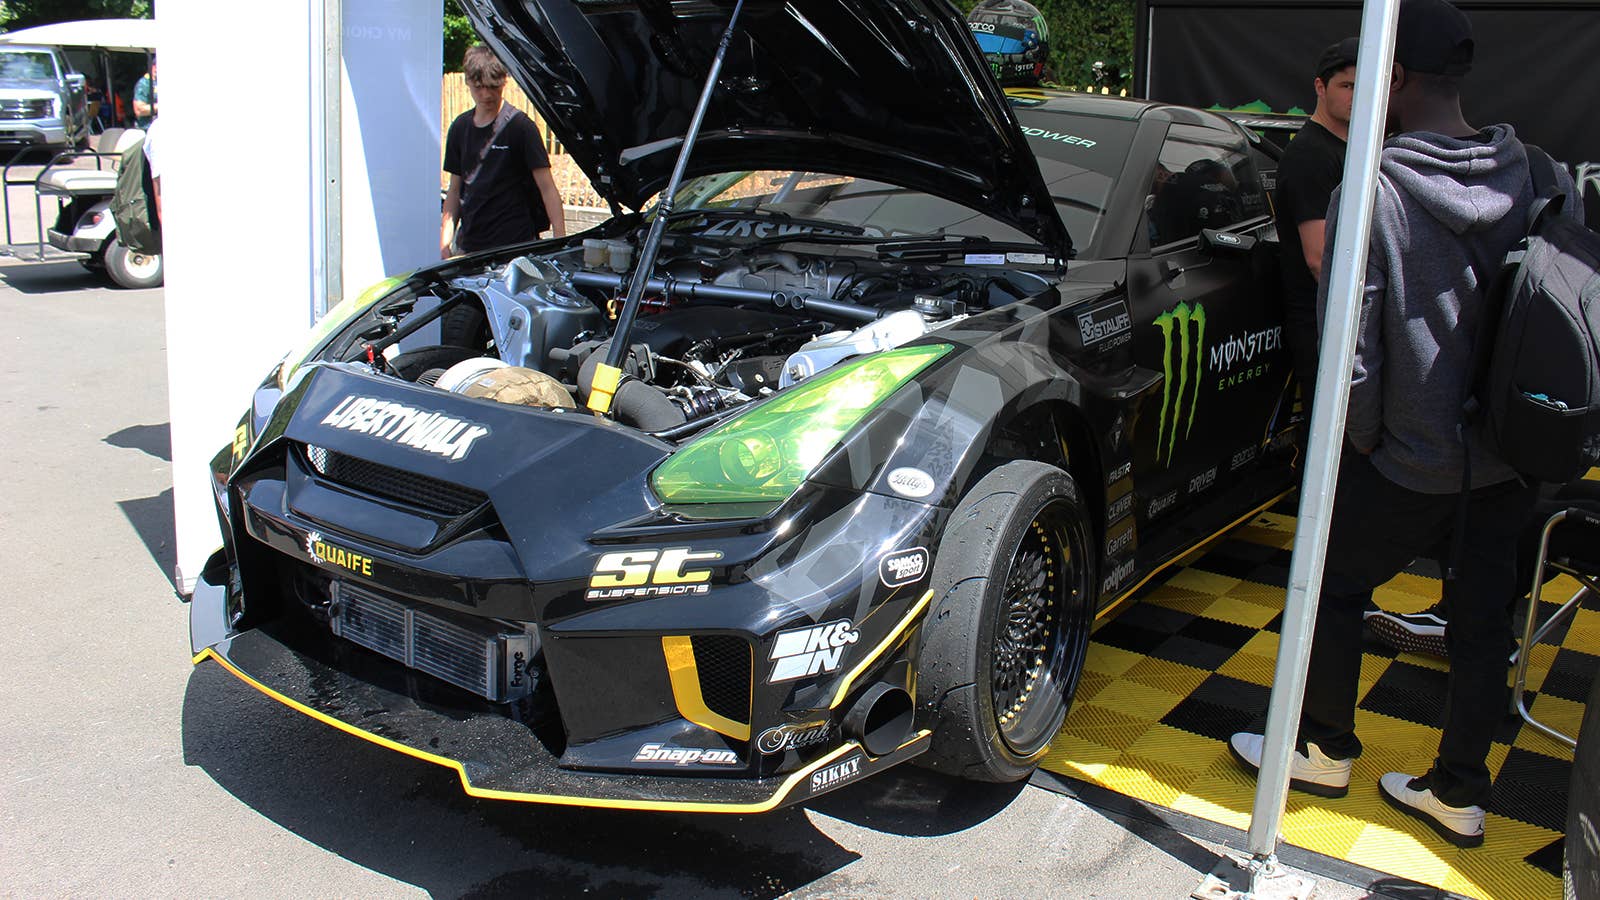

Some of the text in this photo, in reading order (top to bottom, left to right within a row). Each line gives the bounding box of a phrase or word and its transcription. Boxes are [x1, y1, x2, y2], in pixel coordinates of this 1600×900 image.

[1094, 312, 1130, 338] STAUFF
[1209, 326, 1282, 372] MONSTER
[1218, 363, 1271, 390] ENERGY
[1106, 526, 1133, 556] Garrett
[315, 541, 373, 577] QUAIFE
[898, 564, 920, 578] sport
[812, 756, 861, 788] SIKKY
